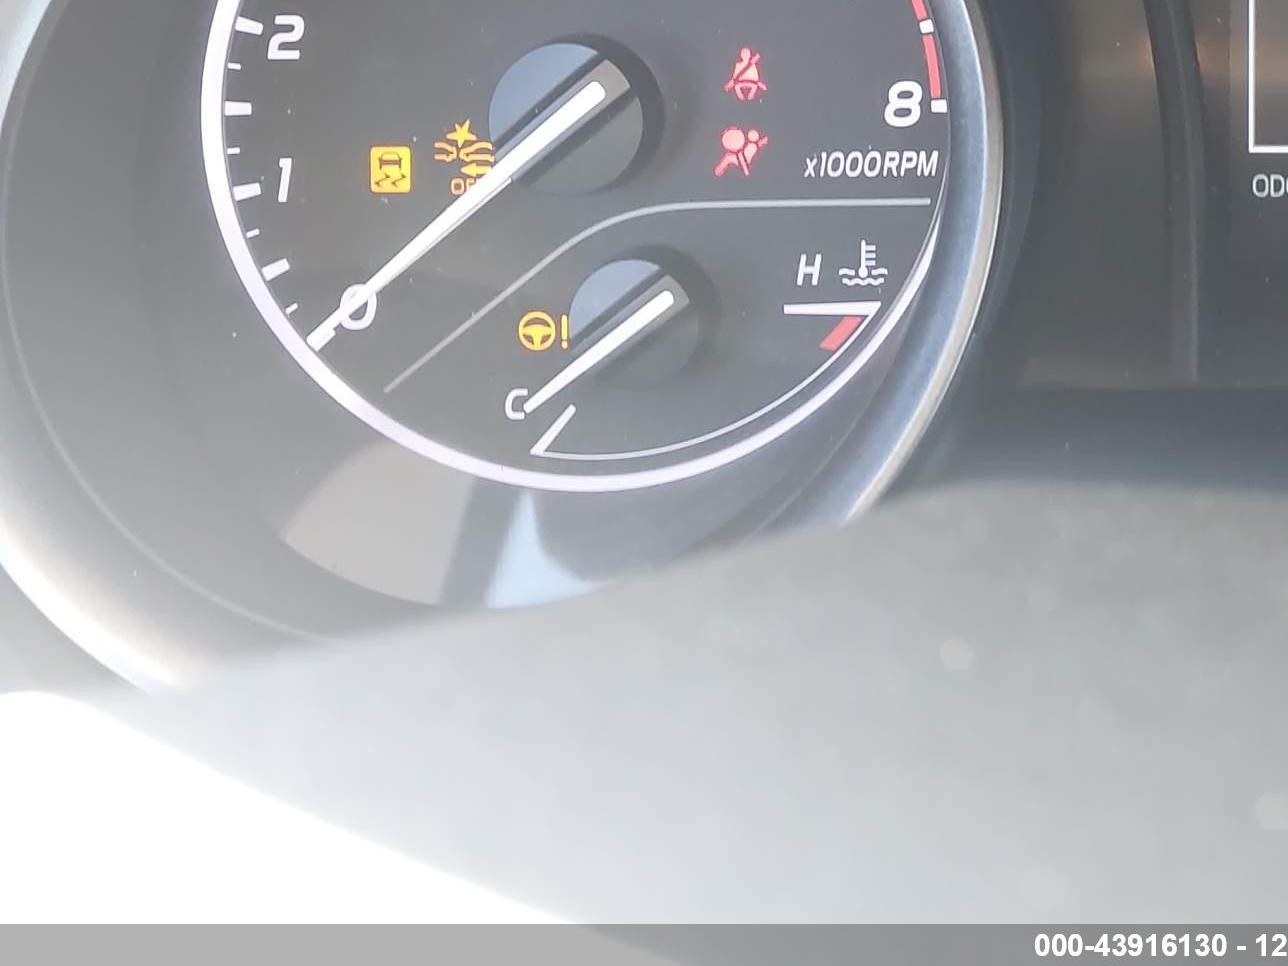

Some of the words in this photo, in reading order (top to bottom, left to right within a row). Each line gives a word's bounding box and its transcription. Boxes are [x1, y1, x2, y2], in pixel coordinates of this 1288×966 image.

[267, 14, 305, 60] 2
[884, 80, 923, 127] 8
[277, 157, 293, 203] 1
[796, 254, 822, 286] H
[504, 388, 529, 420] C
